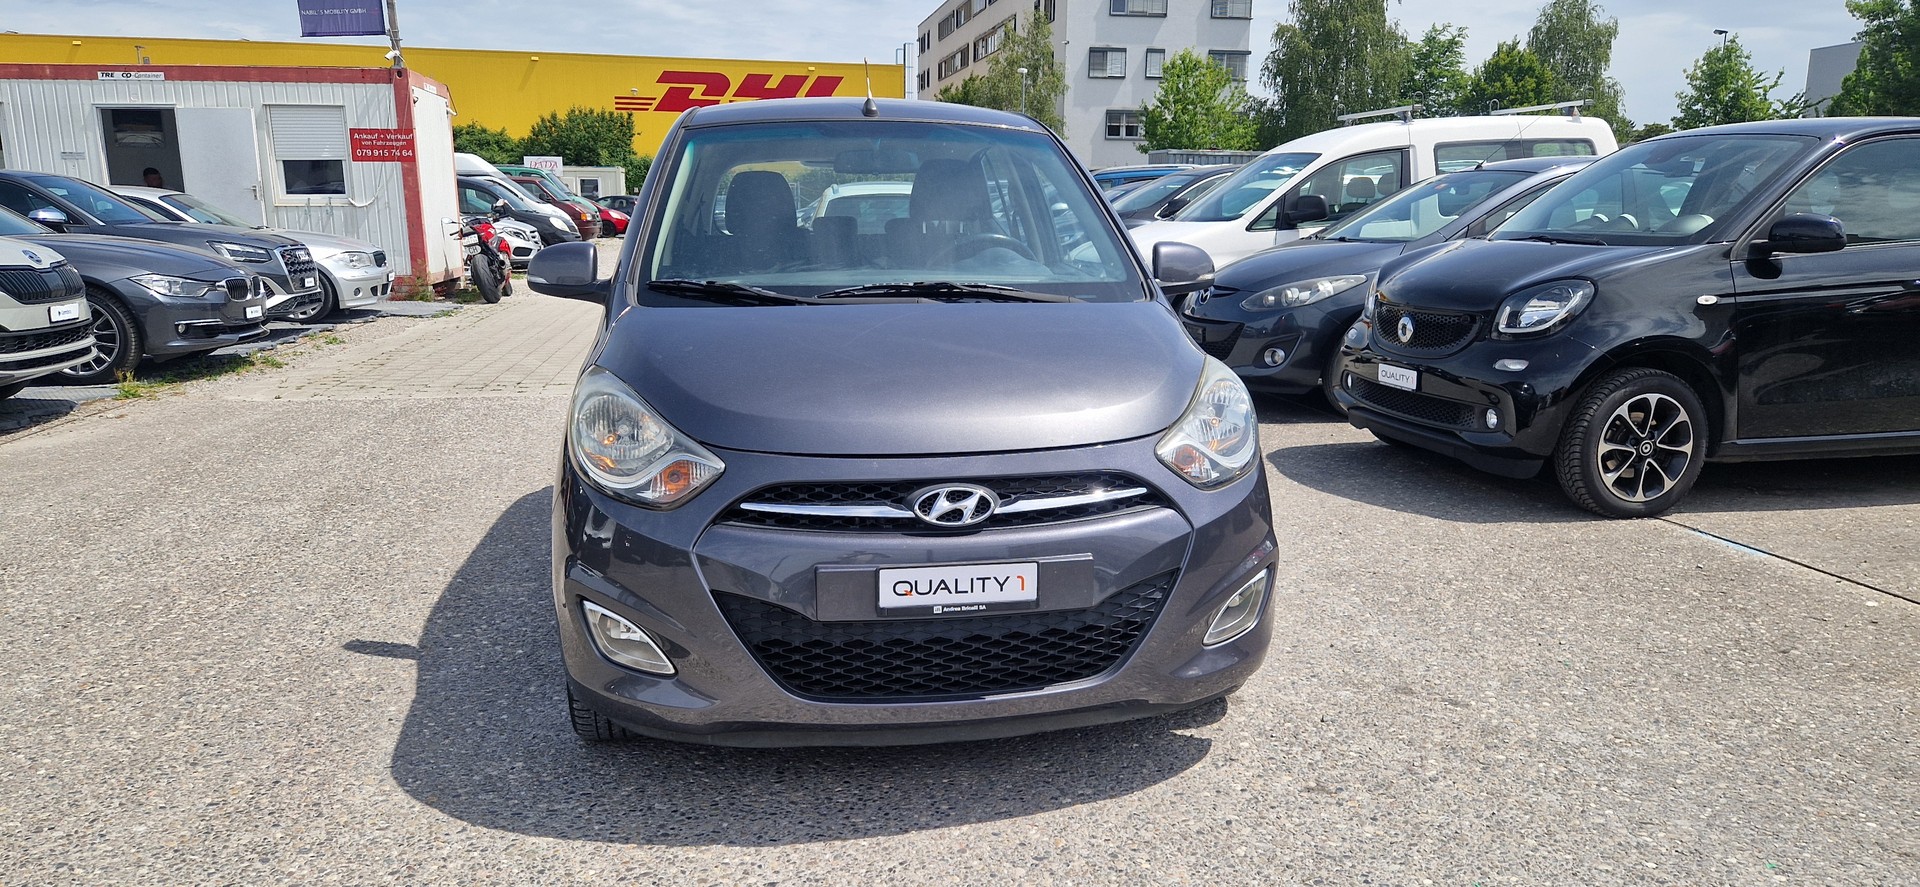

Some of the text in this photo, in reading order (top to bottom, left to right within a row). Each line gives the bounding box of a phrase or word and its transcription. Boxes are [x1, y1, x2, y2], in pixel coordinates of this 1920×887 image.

[353, 132, 378, 140] Ankauf
[402, 149, 413, 157] 64
[468, 246, 479, 254] CH
[1381, 369, 1411, 383] QUALITY
[892, 575, 1025, 597] QUALITY 1
